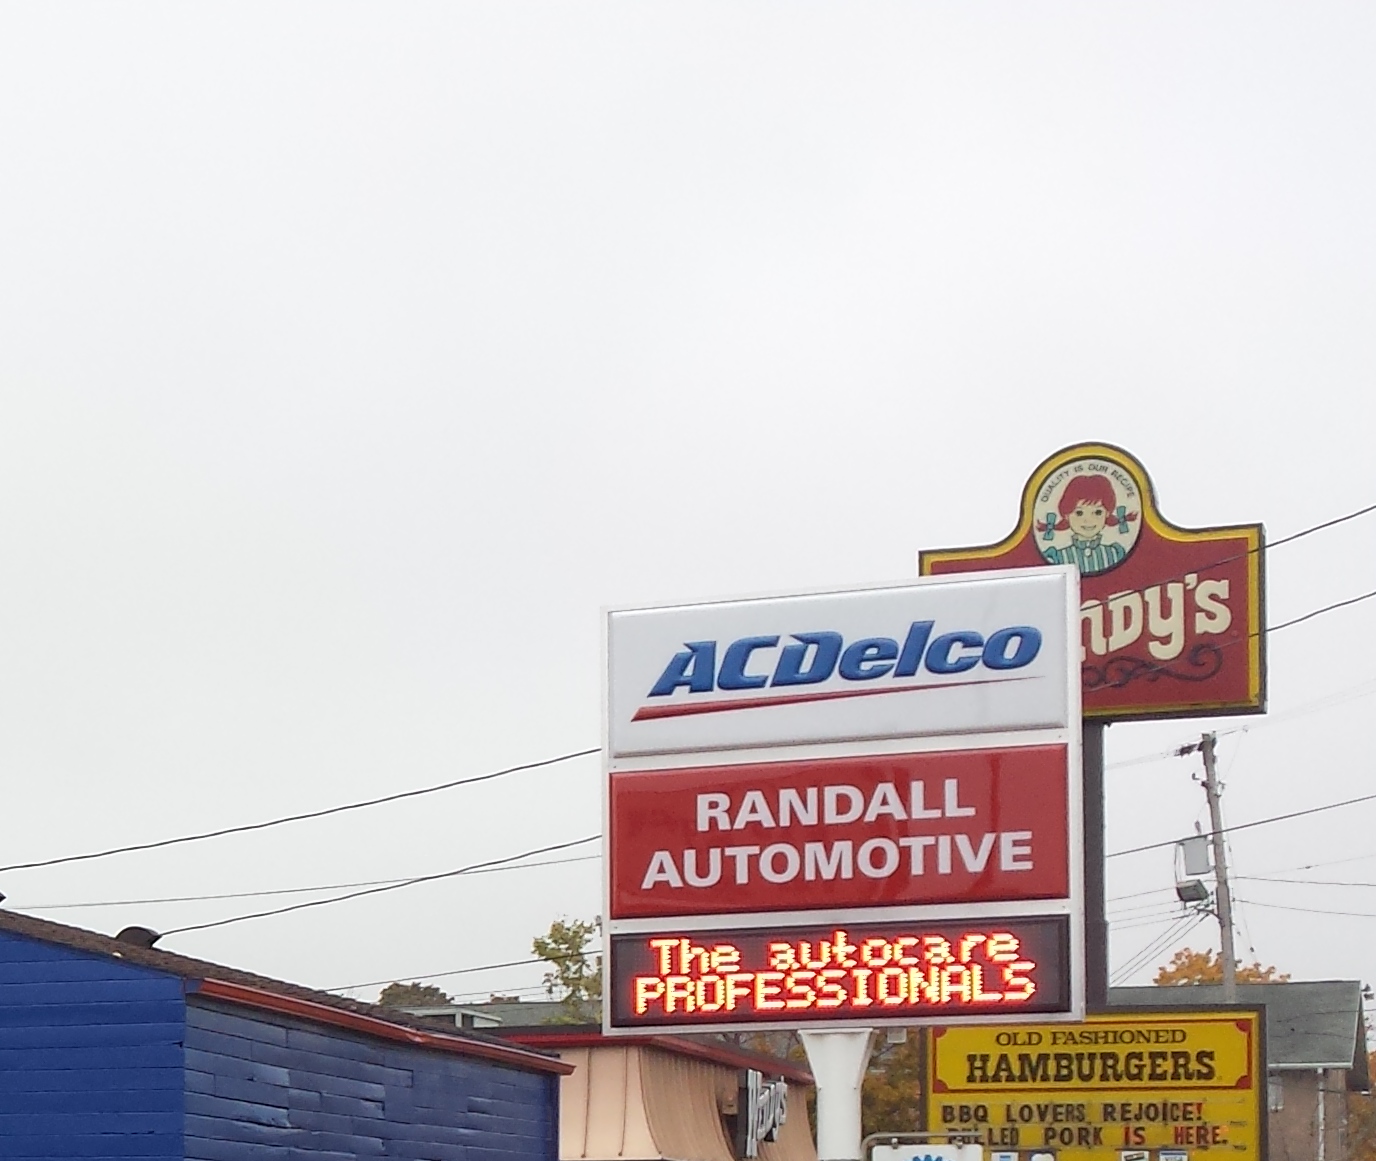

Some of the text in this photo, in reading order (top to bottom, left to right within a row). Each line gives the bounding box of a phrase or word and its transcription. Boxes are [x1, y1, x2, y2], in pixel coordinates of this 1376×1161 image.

[1040, 463, 1136, 503] QUALITY IS OUR RECIPE
[646, 619, 1044, 699] ACDelco
[695, 777, 977, 833] RANDALL
[641, 830, 1035, 891] AUTOMOTIVE
[649, 929, 1022, 976] The autocare
[633, 960, 1038, 1016] PROFESSIONALS
[995, 1029, 1188, 1046] OLD FASHIONED
[965, 1050, 1217, 1084] HAMBURGERS
[941, 1101, 1204, 1124] BBQ LOVERS REJOICE!
[1043, 1126, 1104, 1146] PORK
[1123, 1126, 1146, 1146] IS
